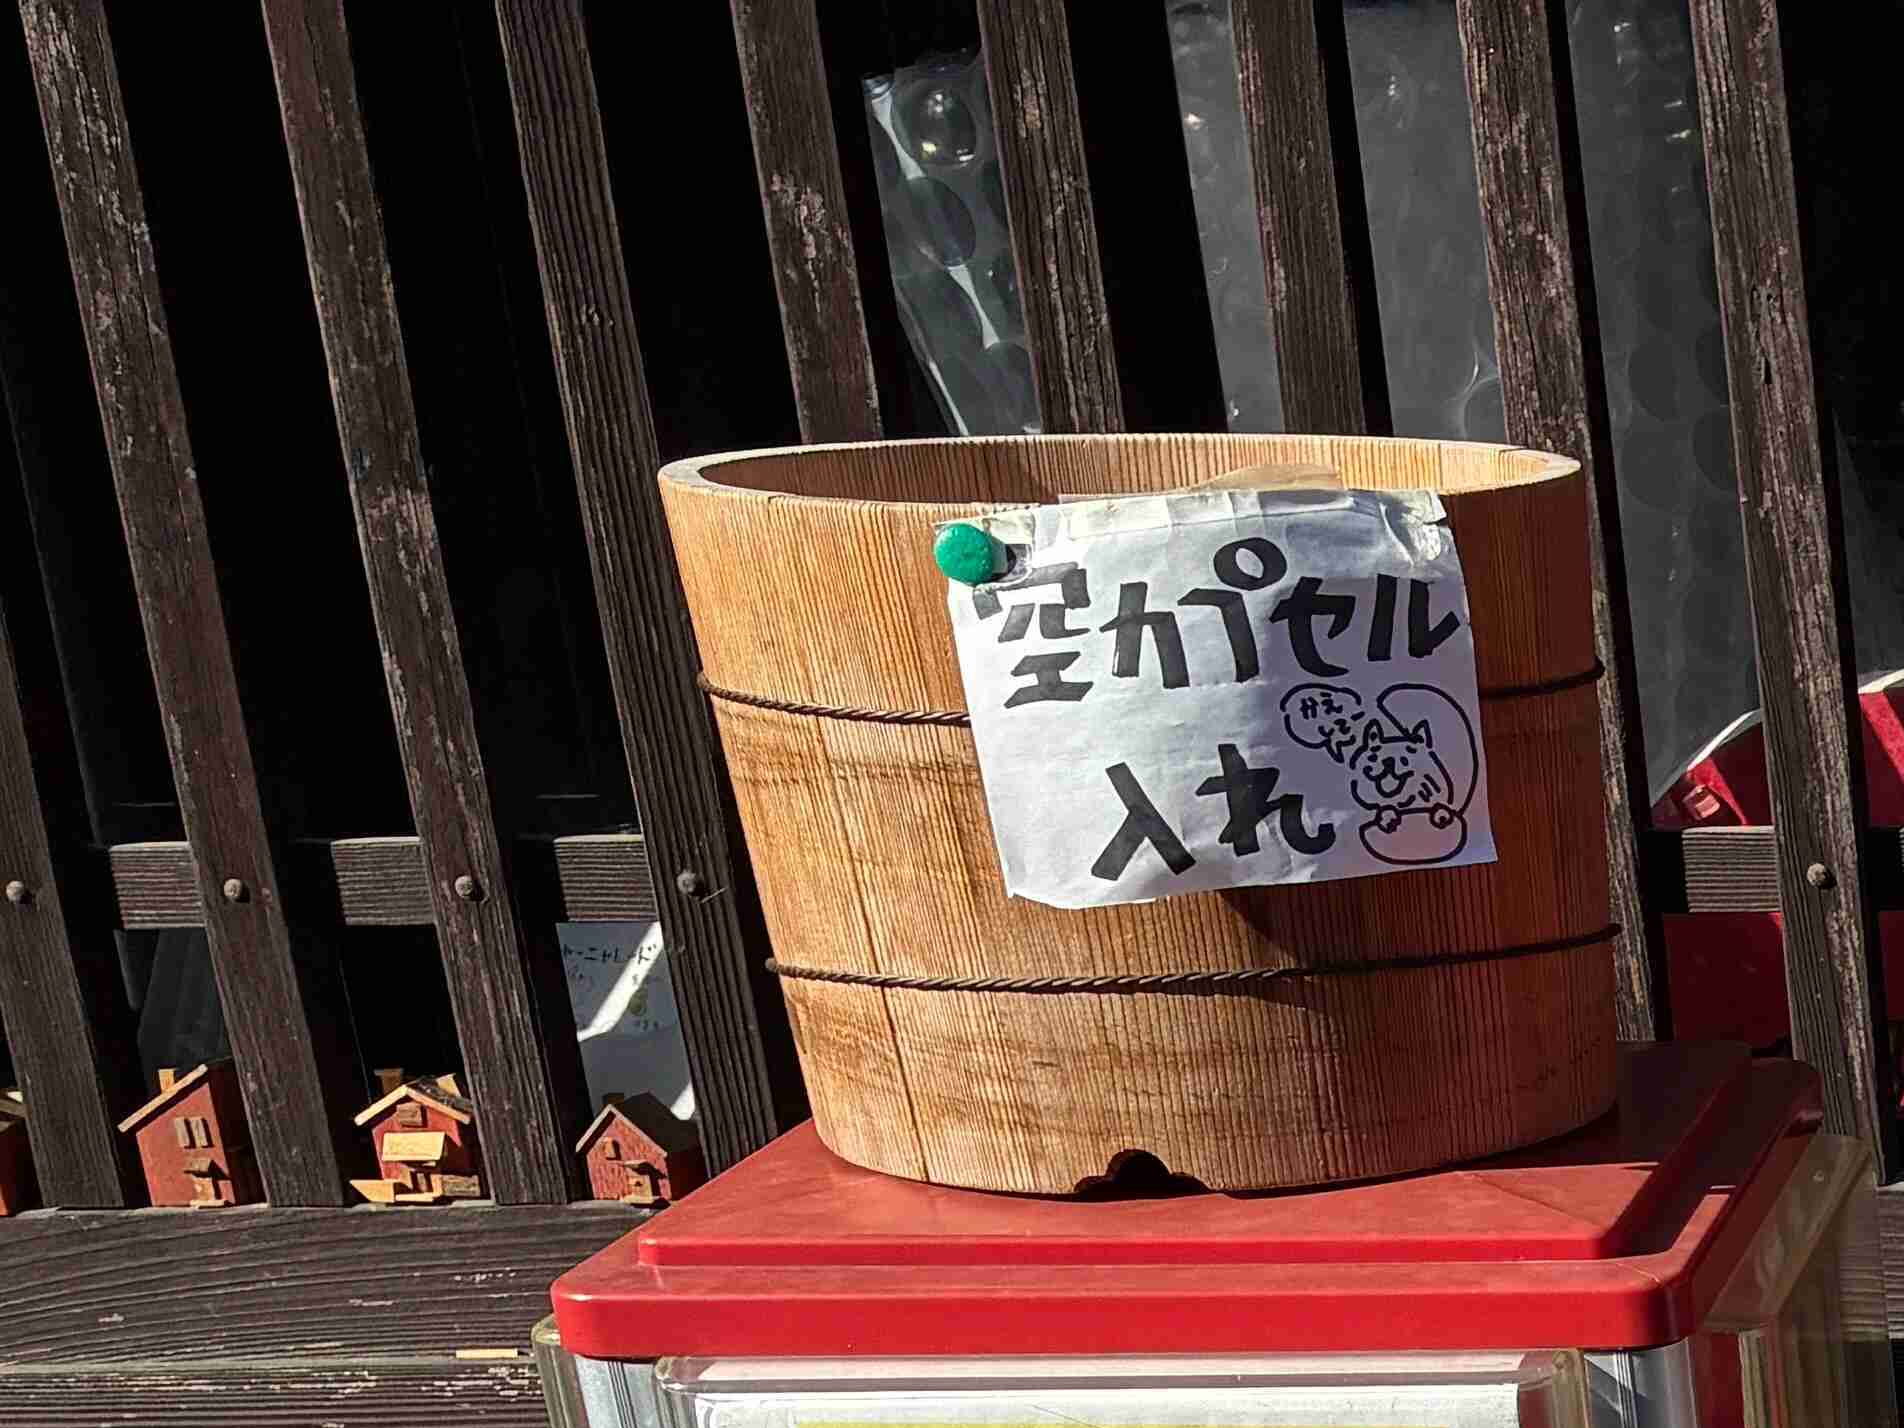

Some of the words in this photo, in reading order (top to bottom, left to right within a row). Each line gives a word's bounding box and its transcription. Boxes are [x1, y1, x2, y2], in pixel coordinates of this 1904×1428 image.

[973, 536, 1462, 707] 空カプセル
[1091, 743, 1336, 881] 入れ
